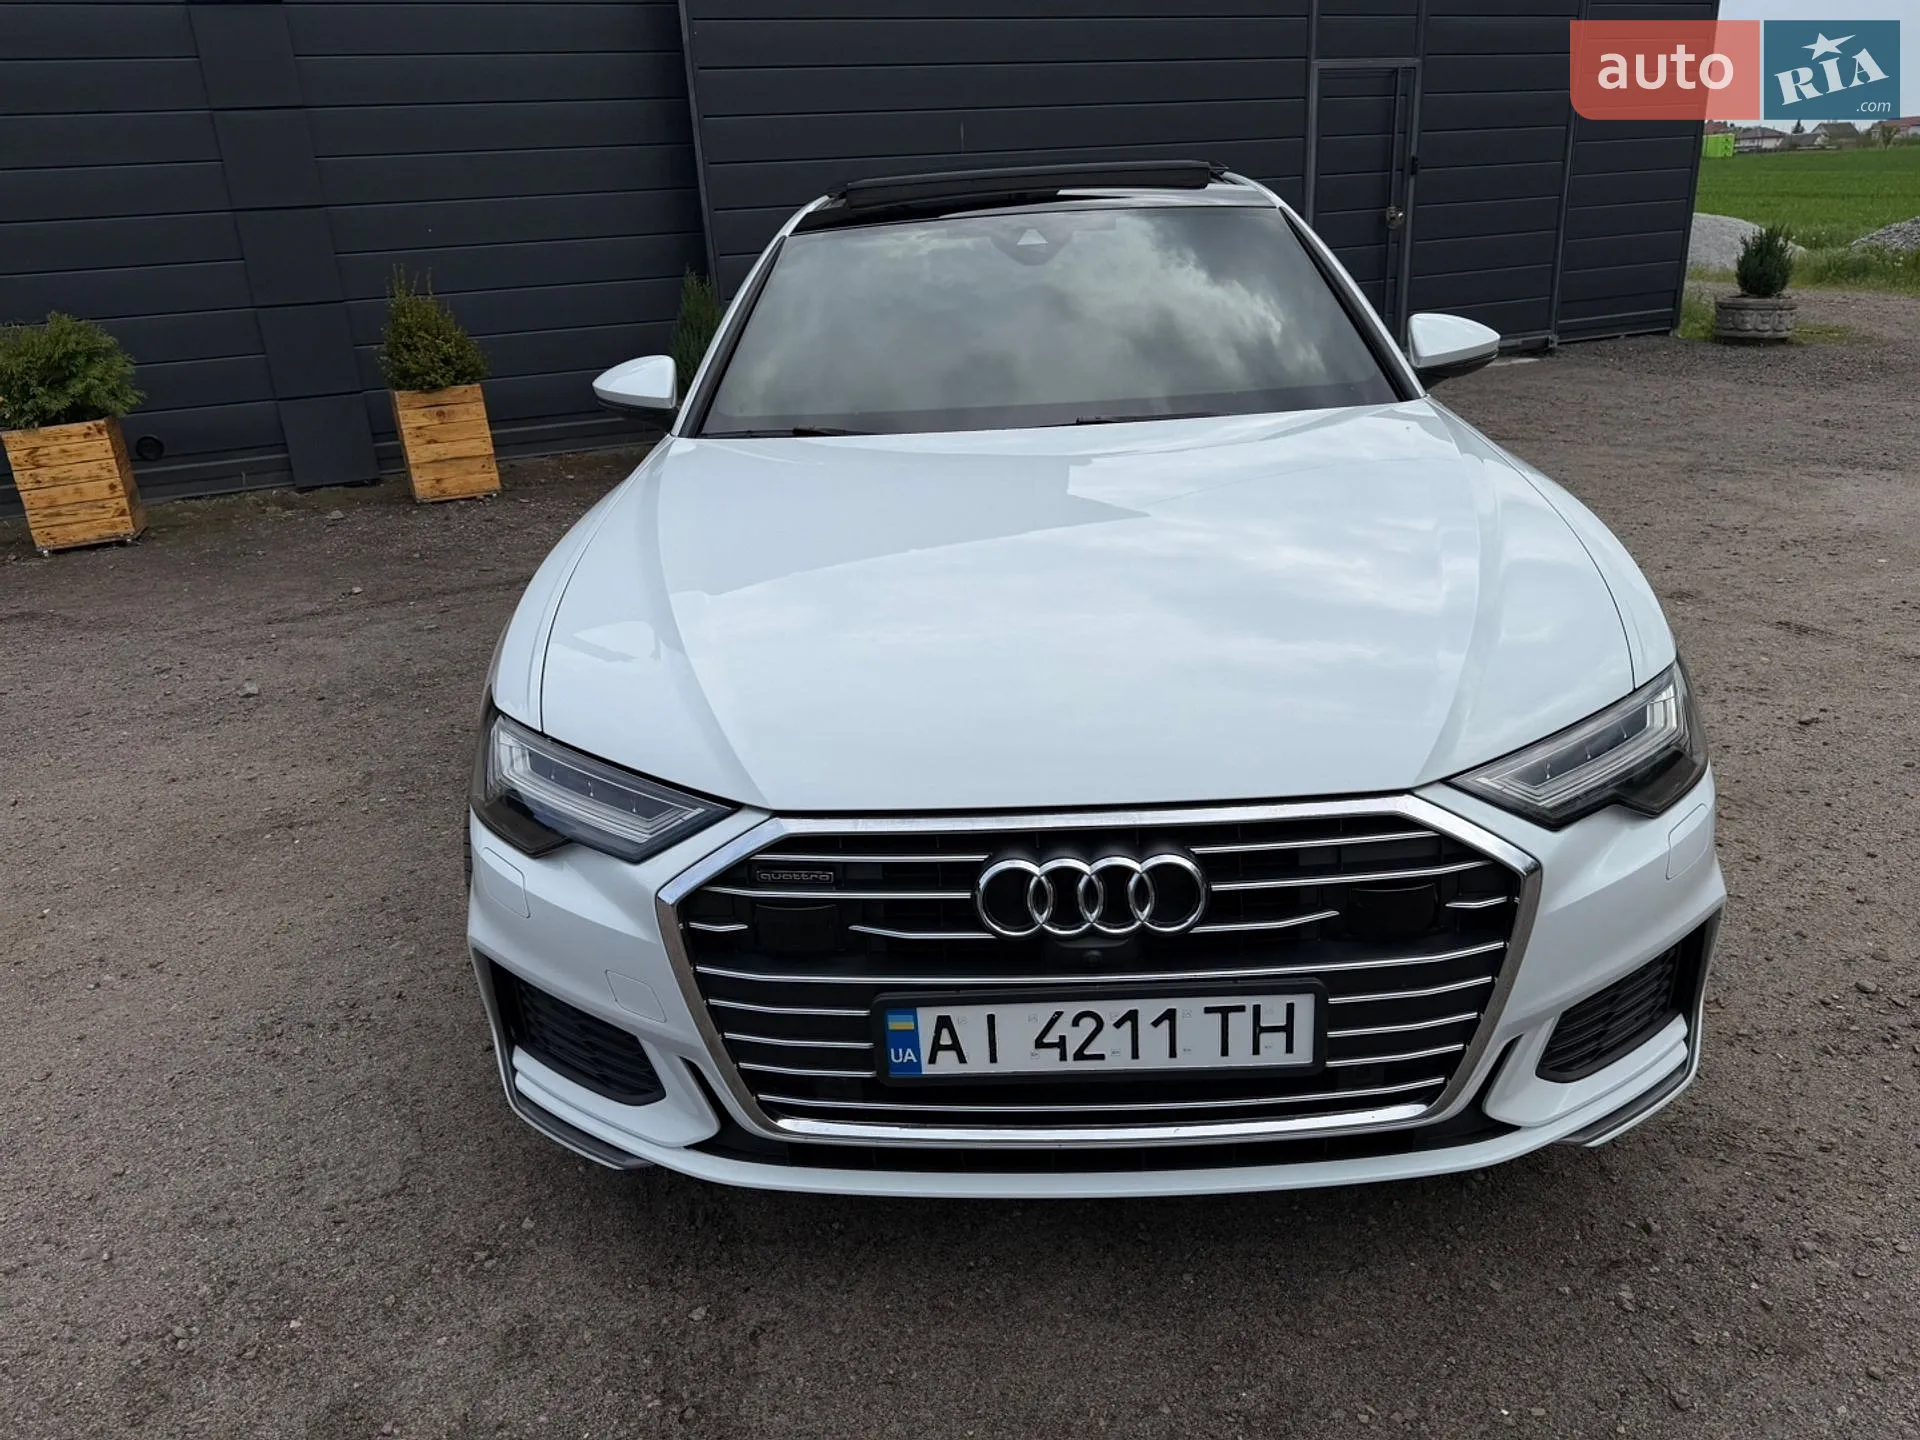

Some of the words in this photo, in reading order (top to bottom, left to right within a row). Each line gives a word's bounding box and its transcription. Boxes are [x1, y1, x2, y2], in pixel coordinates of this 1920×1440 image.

[759, 872, 830, 882] quattro
[1033, 1007, 1178, 1062] 4211
[1203, 1002, 1295, 1057] TH
[890, 1048, 918, 1064] UA
